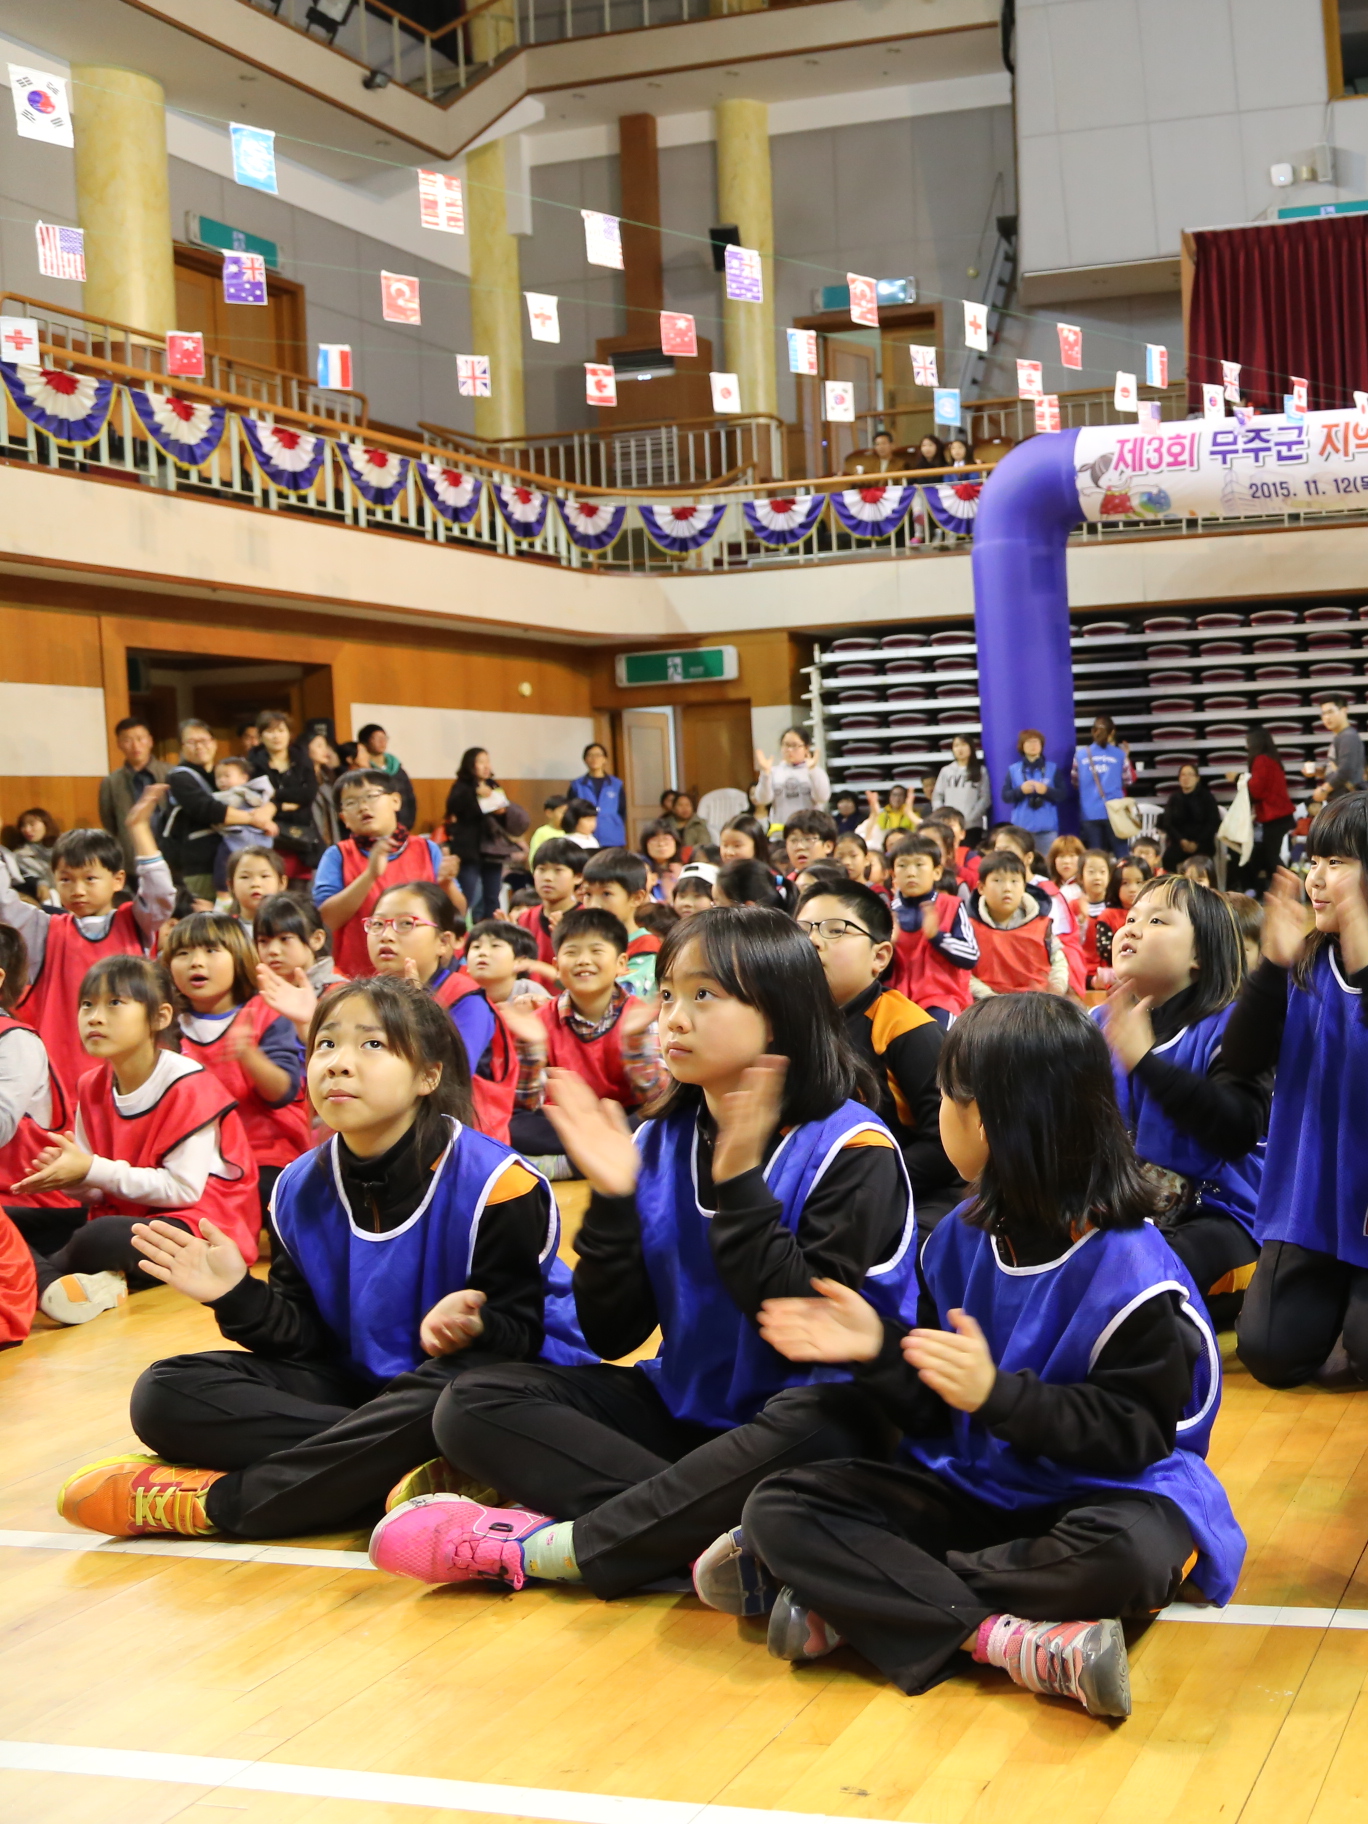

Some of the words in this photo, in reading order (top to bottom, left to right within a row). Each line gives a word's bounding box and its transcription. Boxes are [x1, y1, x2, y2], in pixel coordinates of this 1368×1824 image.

[1113, 432, 1198, 473] 제3회
[1209, 425, 1305, 466] 무주군
[1250, 481, 1297, 499] 2015.
[1304, 479, 1326, 496] 11.
